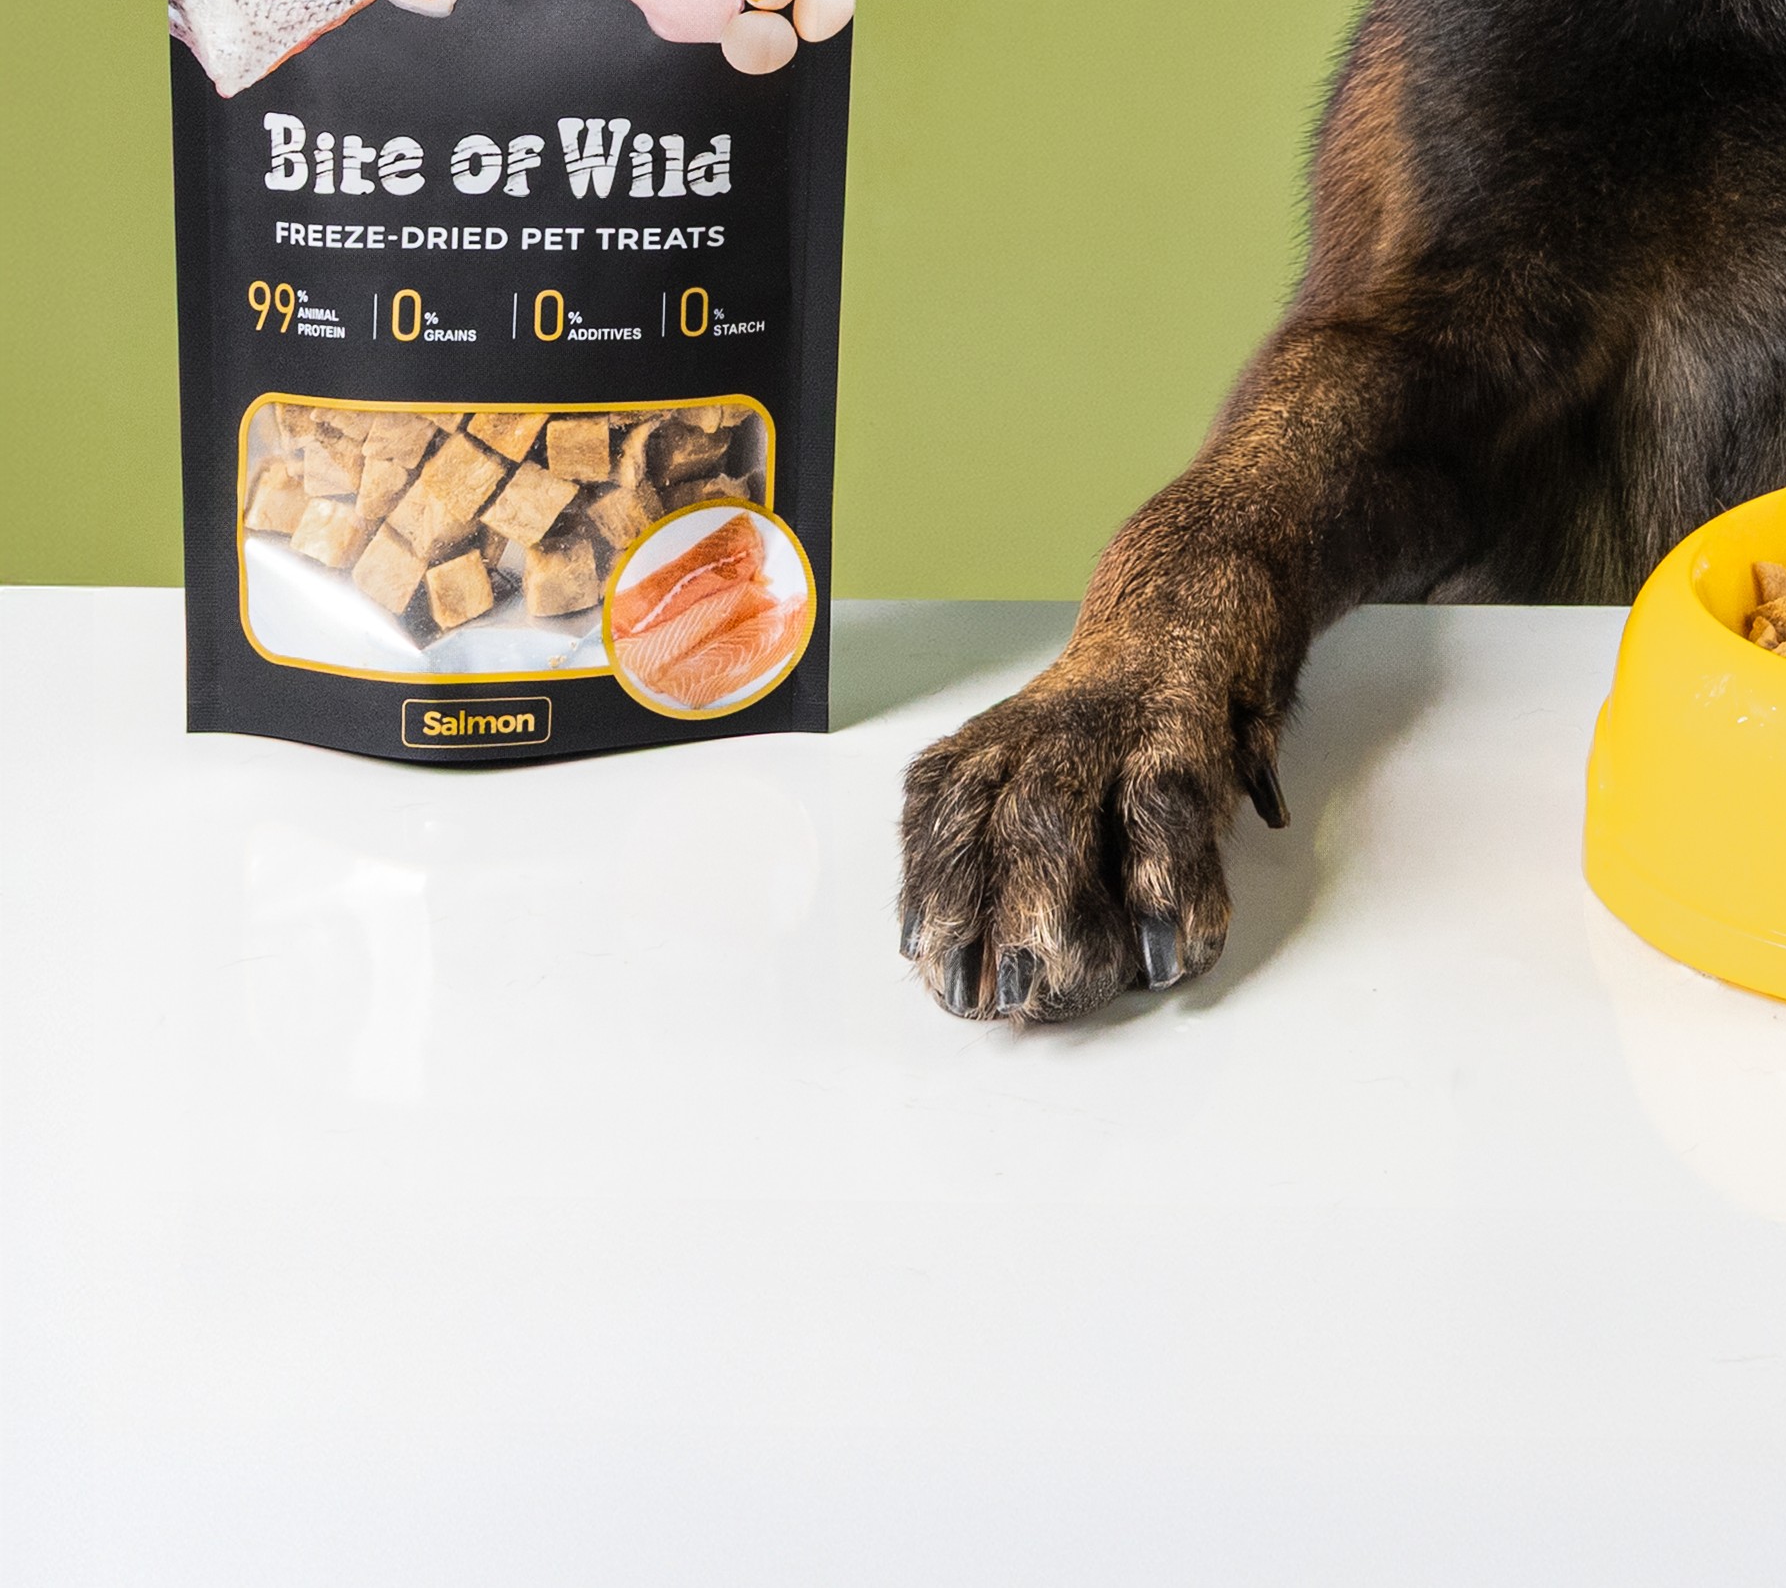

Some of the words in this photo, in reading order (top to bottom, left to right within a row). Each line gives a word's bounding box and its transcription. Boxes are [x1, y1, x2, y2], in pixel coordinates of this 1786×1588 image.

[264, 113, 425, 196] Bite
[451, 135, 545, 197] of
[558, 118, 731, 199] Wild
[276, 222, 508, 249] FREEZE-DRIED
[522, 228, 584, 250] PET
[596, 226, 724, 250] TREATS
[297, 307, 339, 321] ANIMAL
[298, 323, 345, 338] PROTEIN
[424, 329, 476, 341] GRAINS
[568, 328, 641, 340] ADDITIVES
[714, 321, 764, 336] STARCH
[423, 710, 535, 736] Salmon
